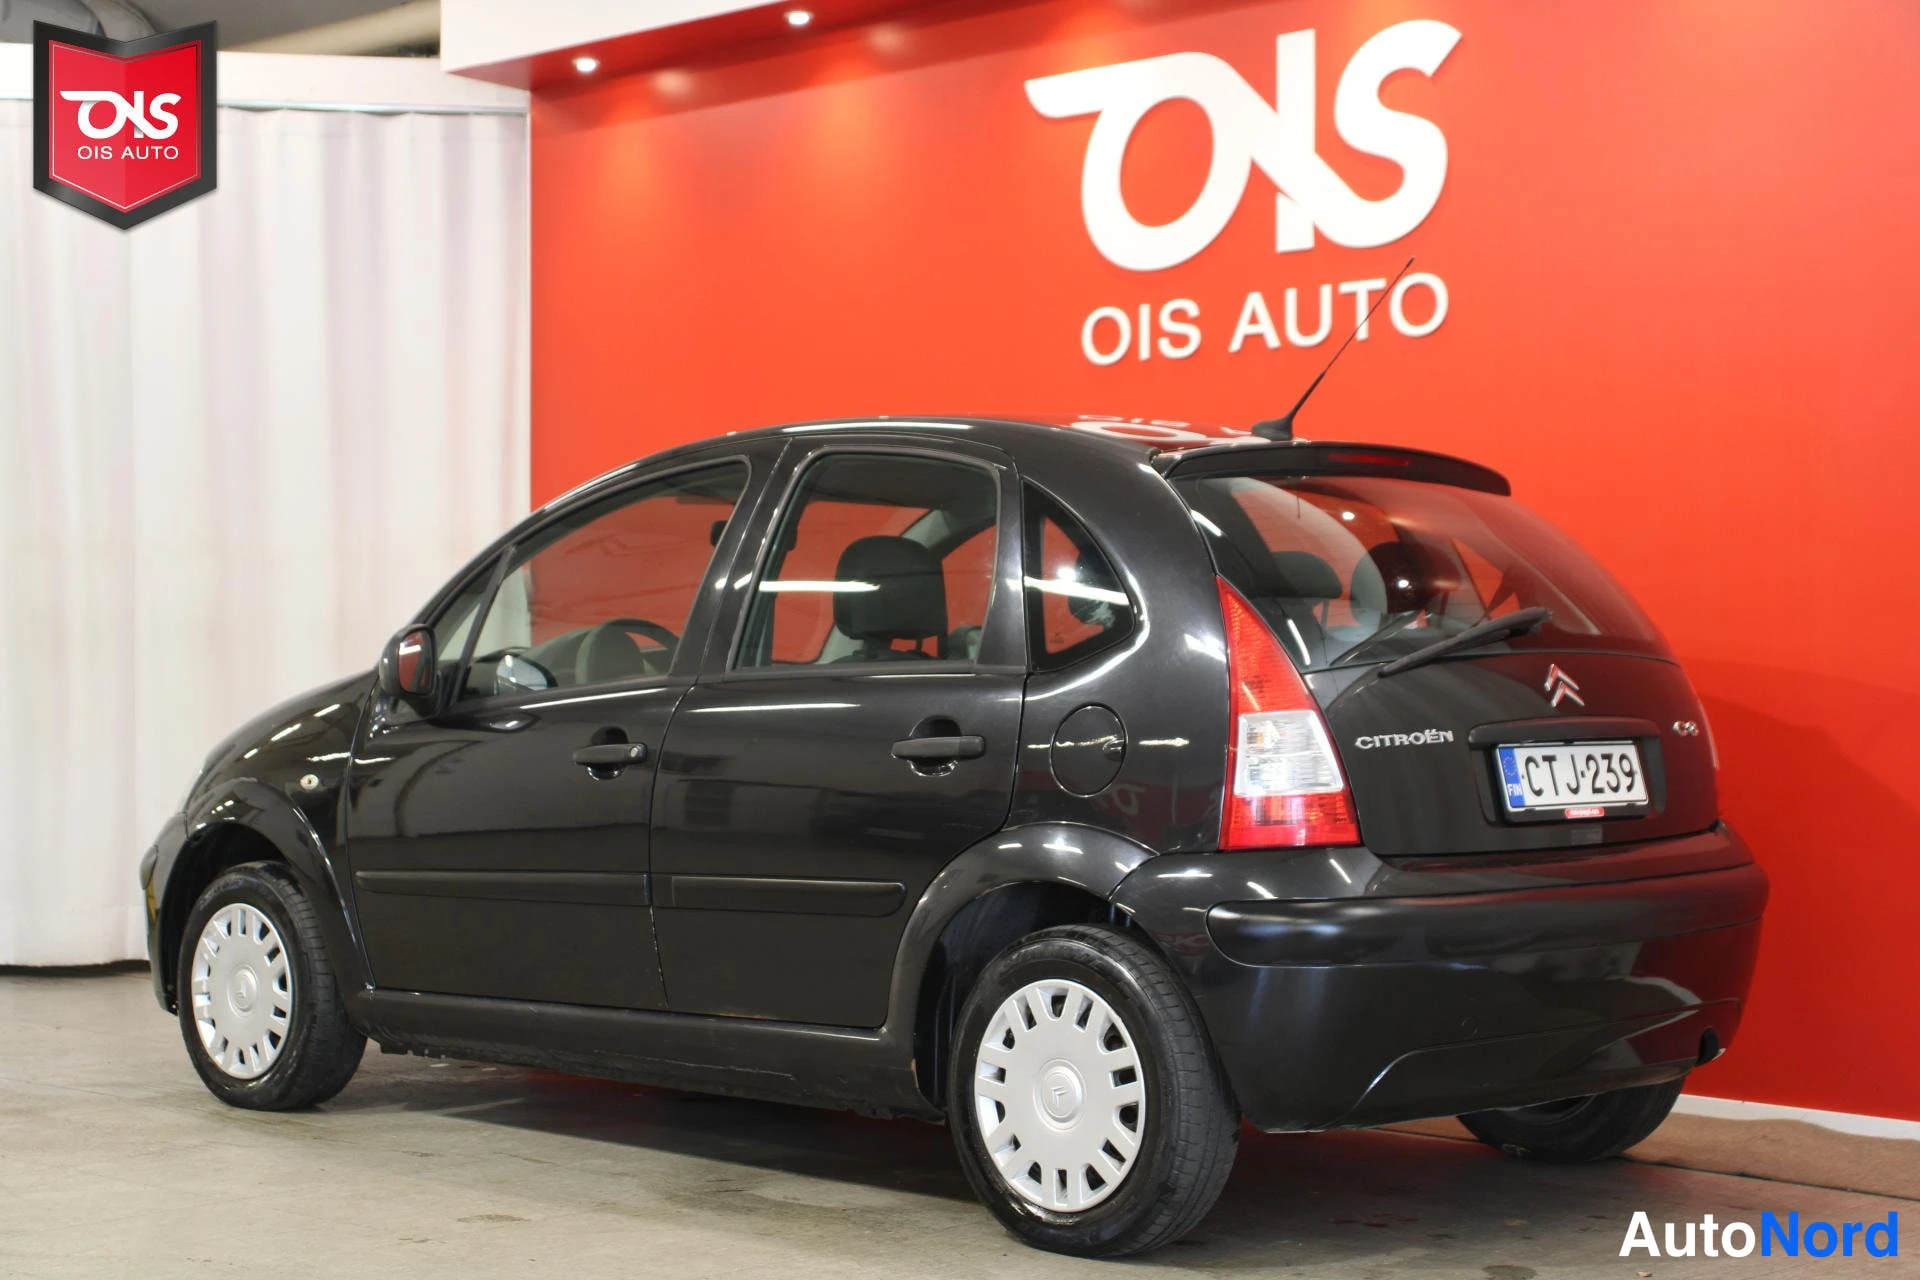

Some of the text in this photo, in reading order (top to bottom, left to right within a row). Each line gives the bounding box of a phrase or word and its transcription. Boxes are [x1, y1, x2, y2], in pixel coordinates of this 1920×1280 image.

[1025, 19, 1463, 271] OIS
[1081, 272, 1449, 366] OIS AUTO
[1507, 783, 1523, 797] FIN
[1525, 753, 1635, 796] CTJ-239
